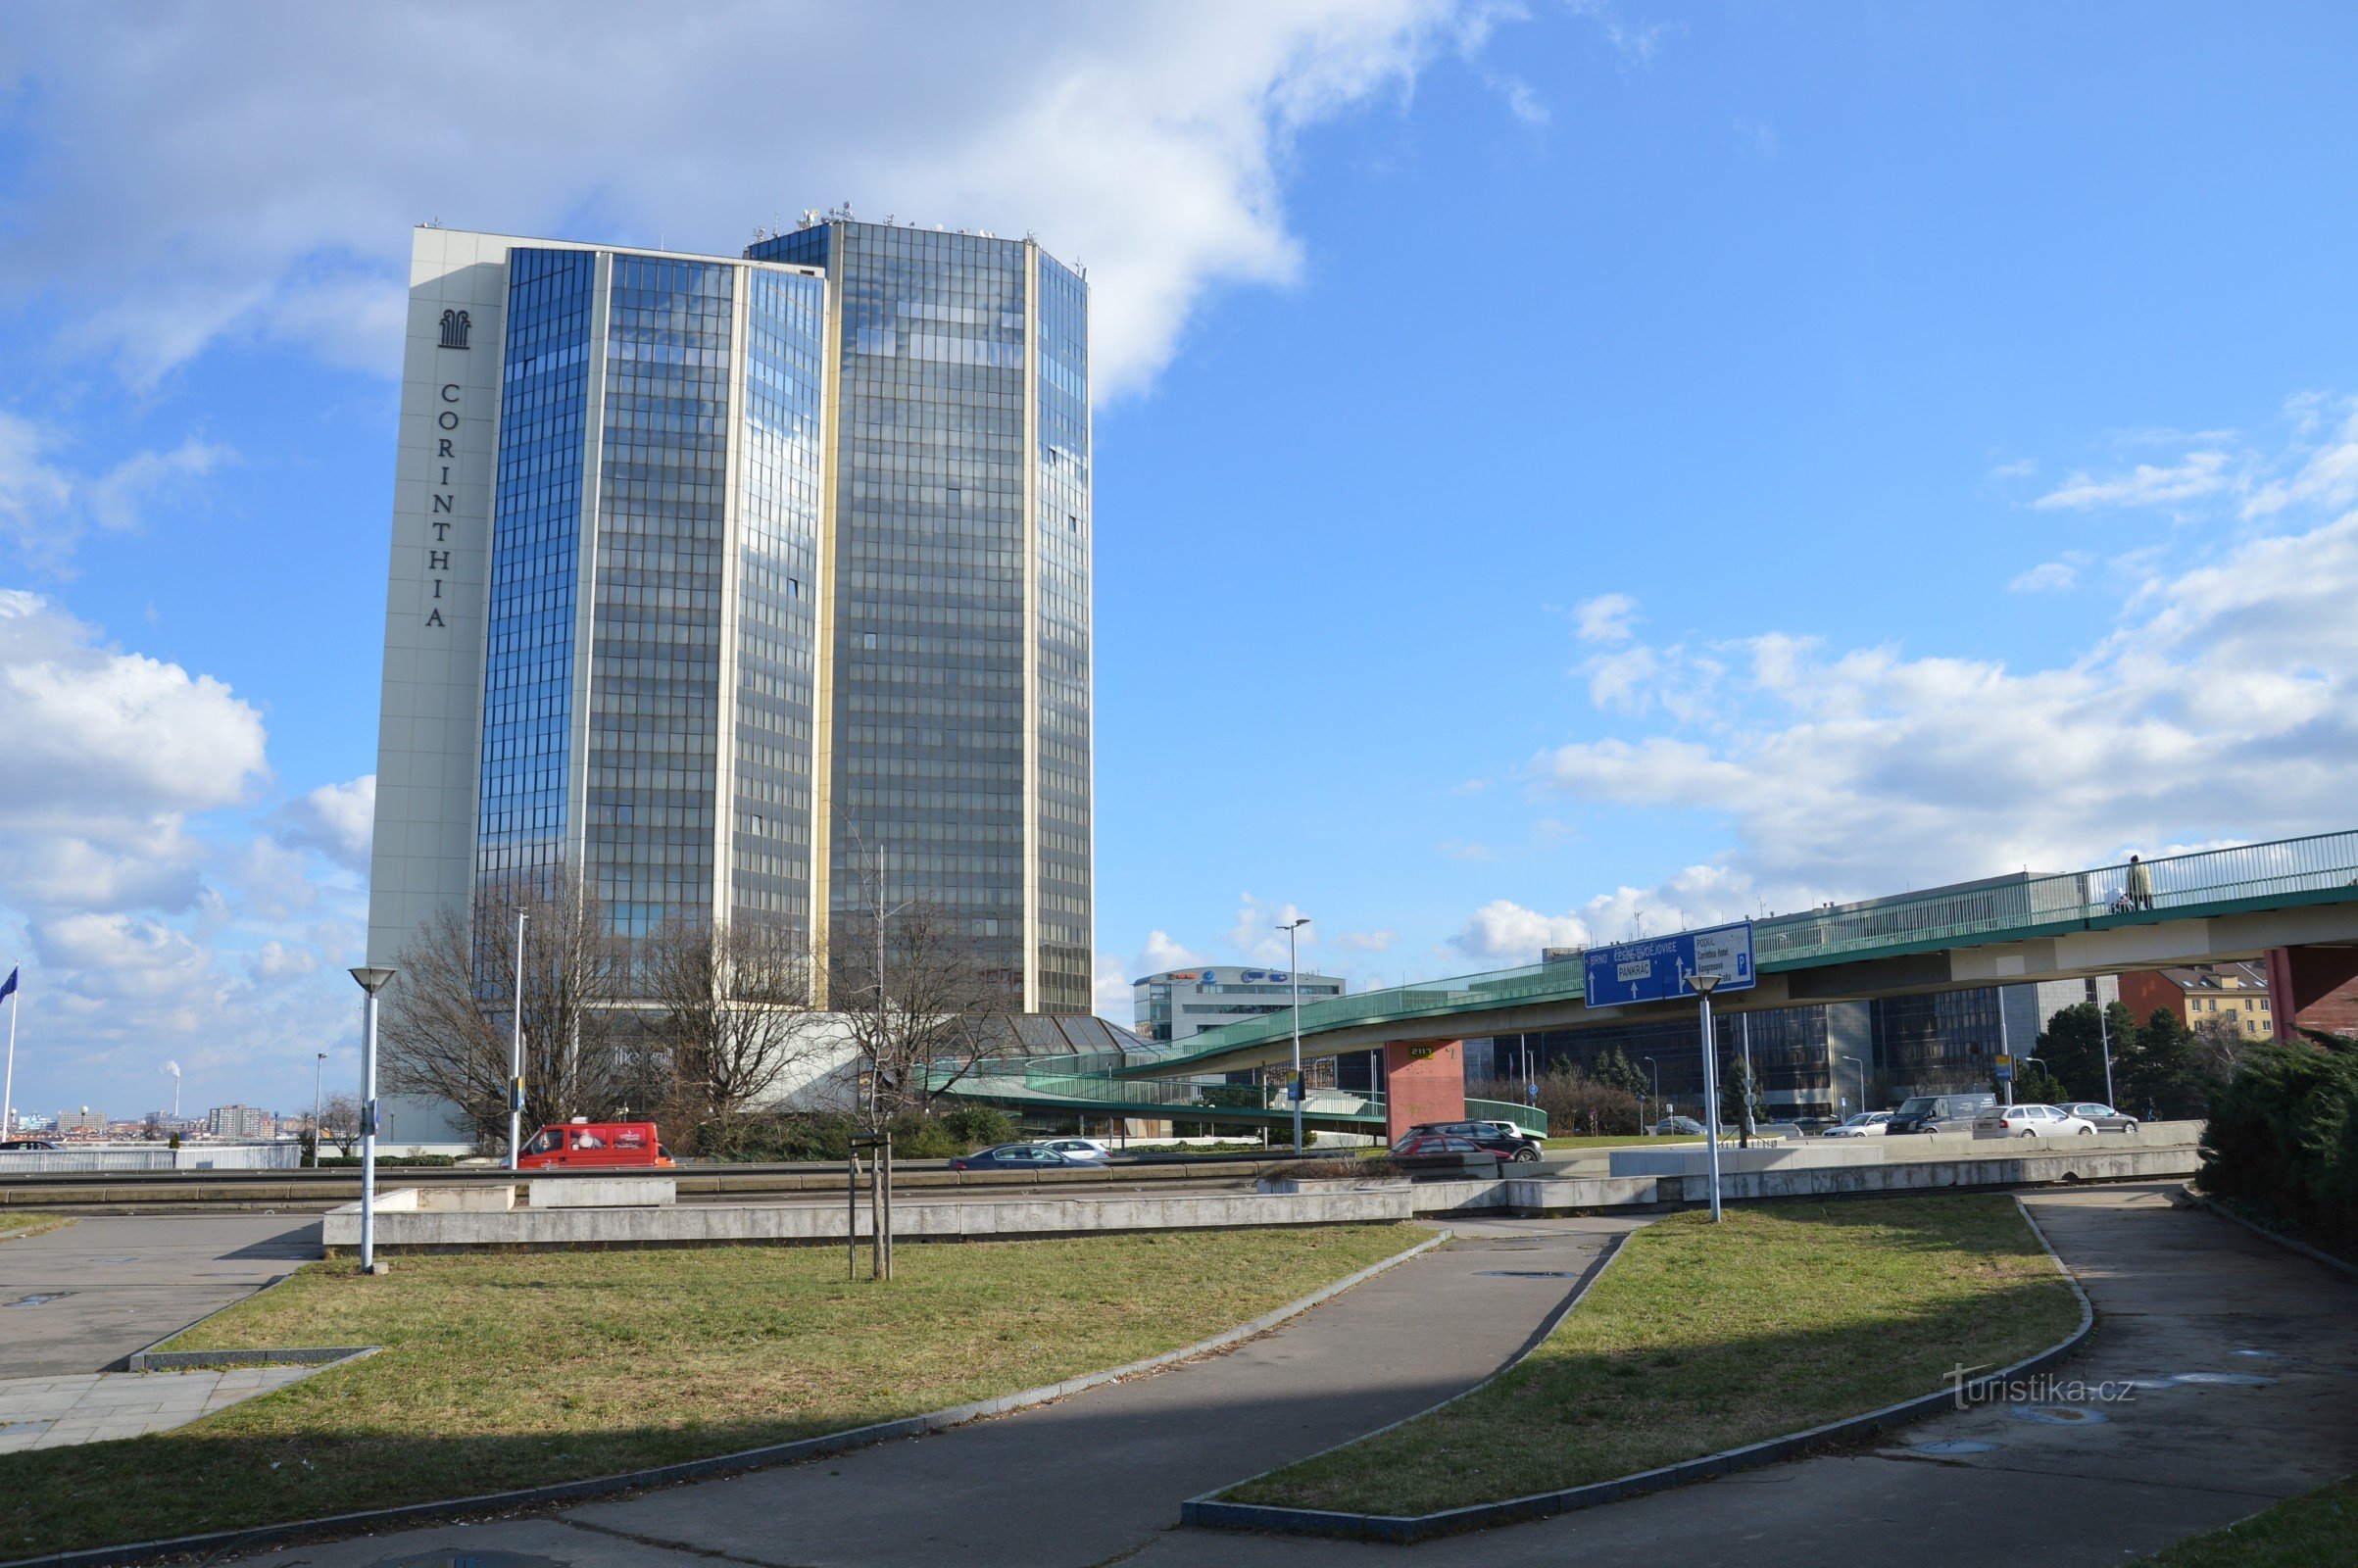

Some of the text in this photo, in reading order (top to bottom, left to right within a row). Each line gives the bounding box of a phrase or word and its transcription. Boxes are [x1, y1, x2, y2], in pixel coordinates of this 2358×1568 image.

[425, 383, 460, 627] CORINTHIA
[1591, 953, 1607, 965] BRNO
[1698, 947, 1729, 960] Corinthia Hotel
[1618, 961, 1649, 978] PANKRÁC
[1697, 963, 1724, 974] Kongresové
[1739, 956, 1744, 970] P
